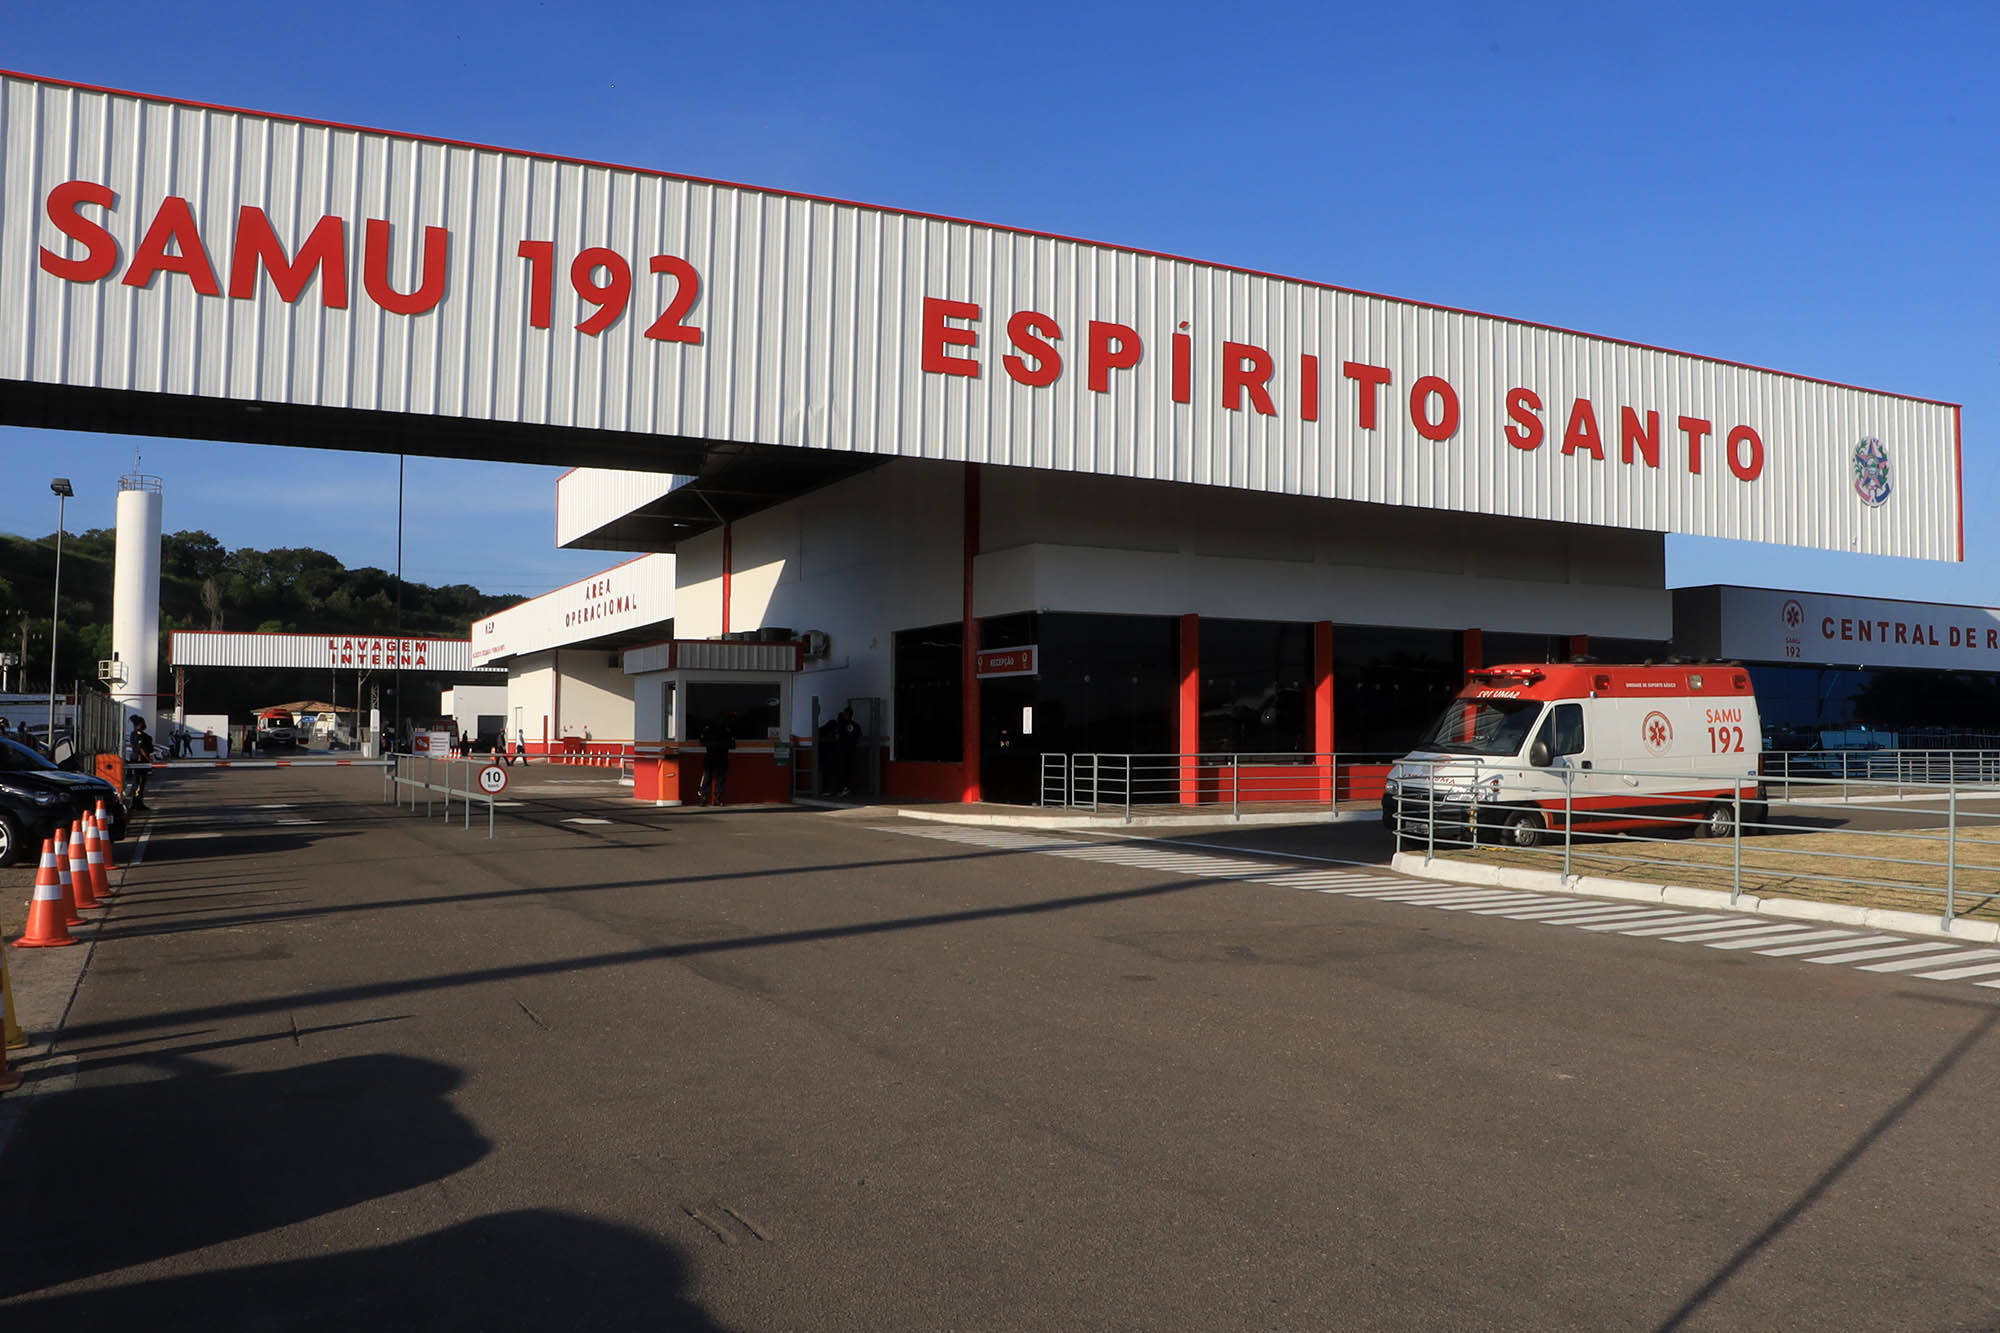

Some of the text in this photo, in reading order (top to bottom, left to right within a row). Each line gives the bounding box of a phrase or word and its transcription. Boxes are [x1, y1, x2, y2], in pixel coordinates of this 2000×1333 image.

[39, 180, 1764, 482] SAMU 192 ESPÍRITO SANTO
[585, 579, 611, 600] ÁREA
[565, 594, 637, 628] OPERACIONAL
[1821, 617, 1939, 646] CENTRAL
[1949, 626, 1977, 648] DE
[328, 640, 428, 653] LAVAGEM
[1786, 646, 1801, 658] 192
[331, 653, 426, 666] INTERNA
[1705, 708, 1742, 723] SAMU
[1708, 726, 1745, 754] 192
[485, 771, 501, 783] 10
